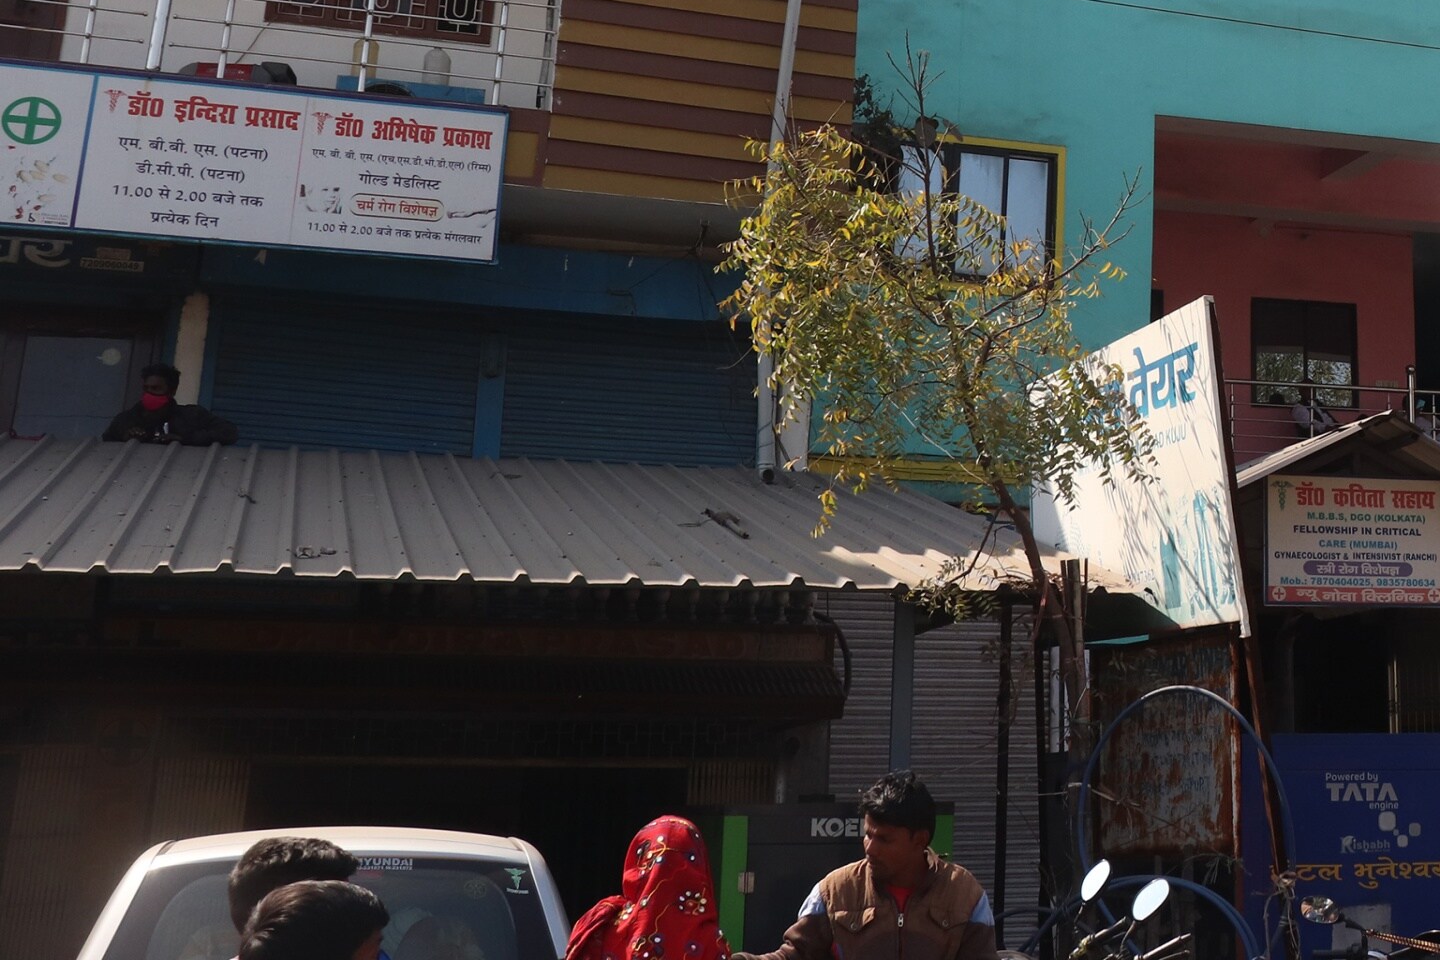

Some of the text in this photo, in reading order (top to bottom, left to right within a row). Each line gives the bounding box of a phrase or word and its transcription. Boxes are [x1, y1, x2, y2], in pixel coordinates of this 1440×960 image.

[174, 96, 238, 124] इन्दिरा
[245, 106, 301, 130] प्रसाद
[443, 127, 493, 150] प्रकाश
[224, 145, 268, 161] (पटना)
[200, 166, 245, 183] (पटना)
[359, 170, 442, 190] गोल्ड मेडलिस्ट
[113, 184, 264, 207] 11.00 से 2.00 बजे तक
[356, 197, 375, 211] चर्म
[378, 198, 395, 213] रोग
[151, 210, 219, 227] प्रत्येक दिन
[1332, 483, 1385, 509] कविता
[1390, 490, 1436, 510] सहाय
[1350, 513, 1371, 522] DGO
[1374, 514, 1426, 524] (KOLKATA)
[1293, 525, 1421, 536] FELLOWSHIP IN CRITICAL
[1319, 540, 1398, 550] CARE (MUMBAI)
[1274, 551, 1340, 560] GYNAECOLOGIST
[1353, 553, 1401, 561] INTENSIVIST
[1403, 553, 1438, 562] (RANCHI)
[1338, 564, 1358, 575] रोग
[1296, 588, 1425, 604] न्यू नोवा क्लिनिक
[1325, 772, 1379, 783] Powered by
[1326, 783, 1398, 802] TATA
[1369, 802, 1399, 811] engine
[1340, 835, 1391, 854] Rishabh
